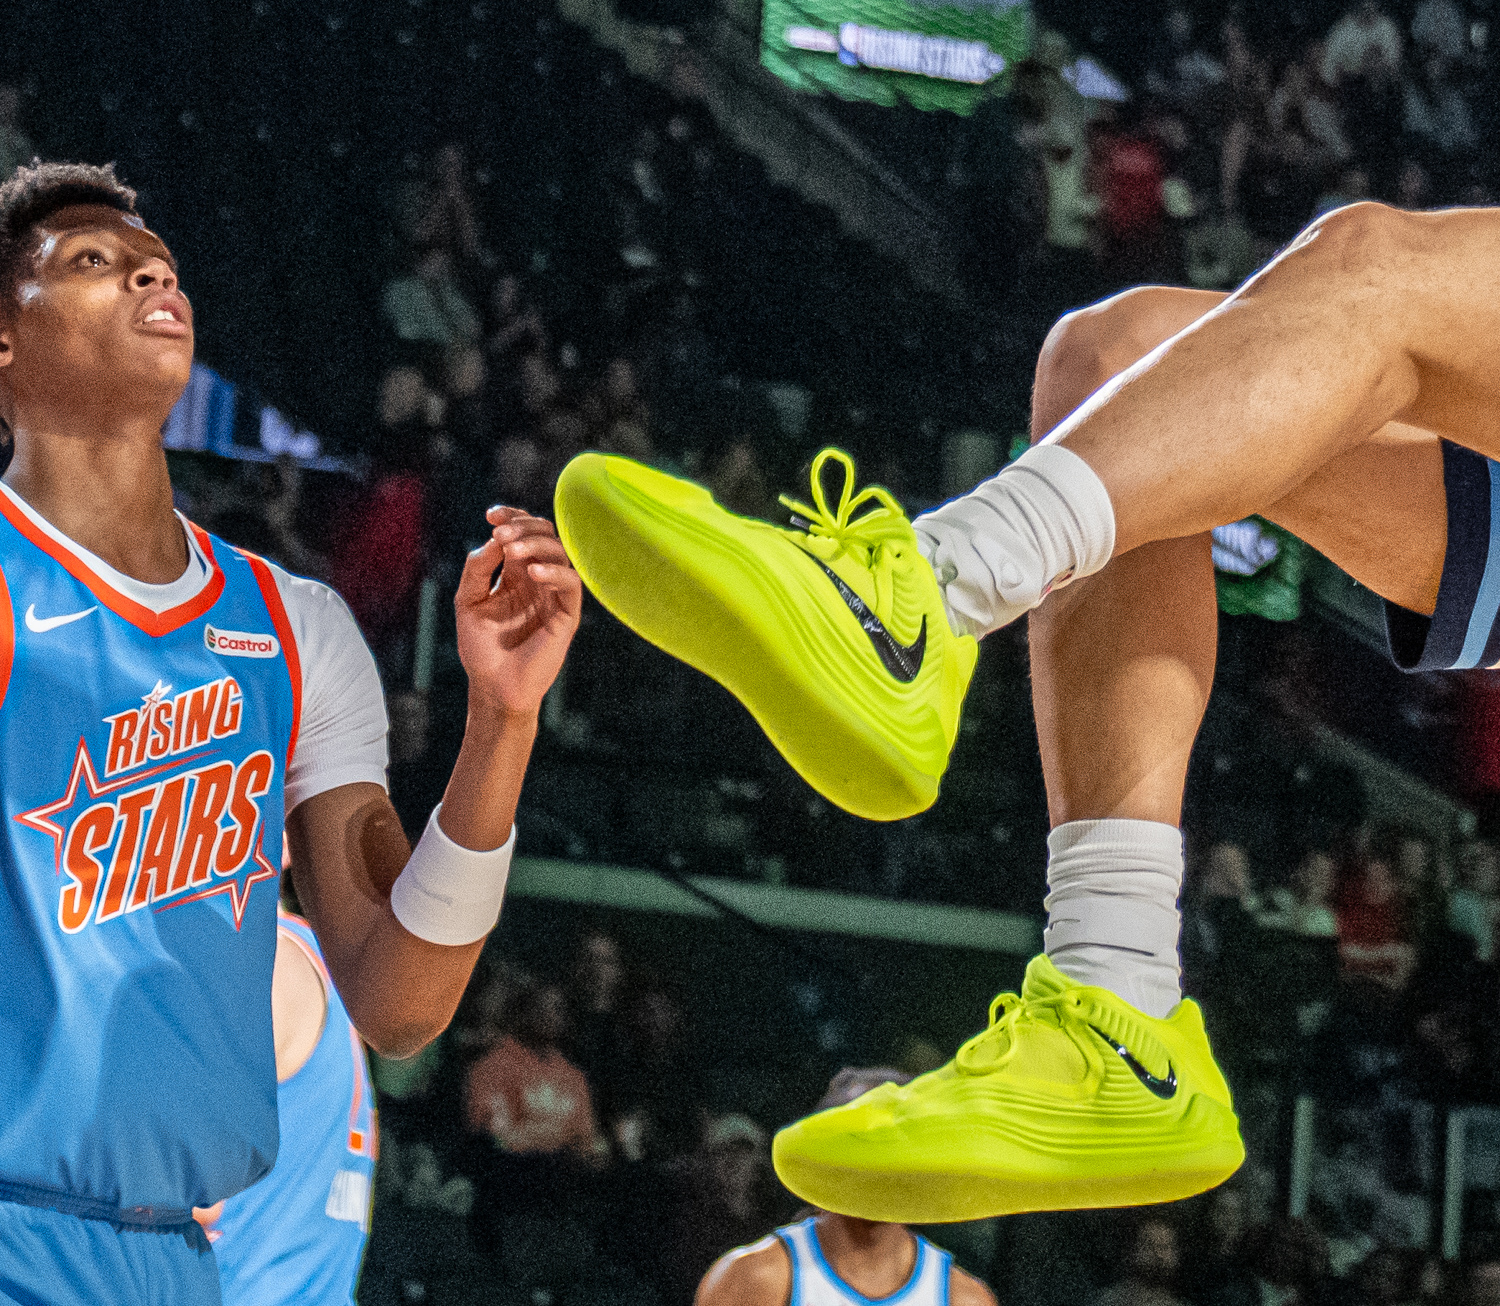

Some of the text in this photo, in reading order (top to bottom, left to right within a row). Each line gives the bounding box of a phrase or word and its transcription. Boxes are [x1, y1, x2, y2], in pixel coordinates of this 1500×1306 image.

[217, 636, 273, 653] Castrol
[102, 676, 243, 778] RISING
[58, 750, 274, 935] STARS
